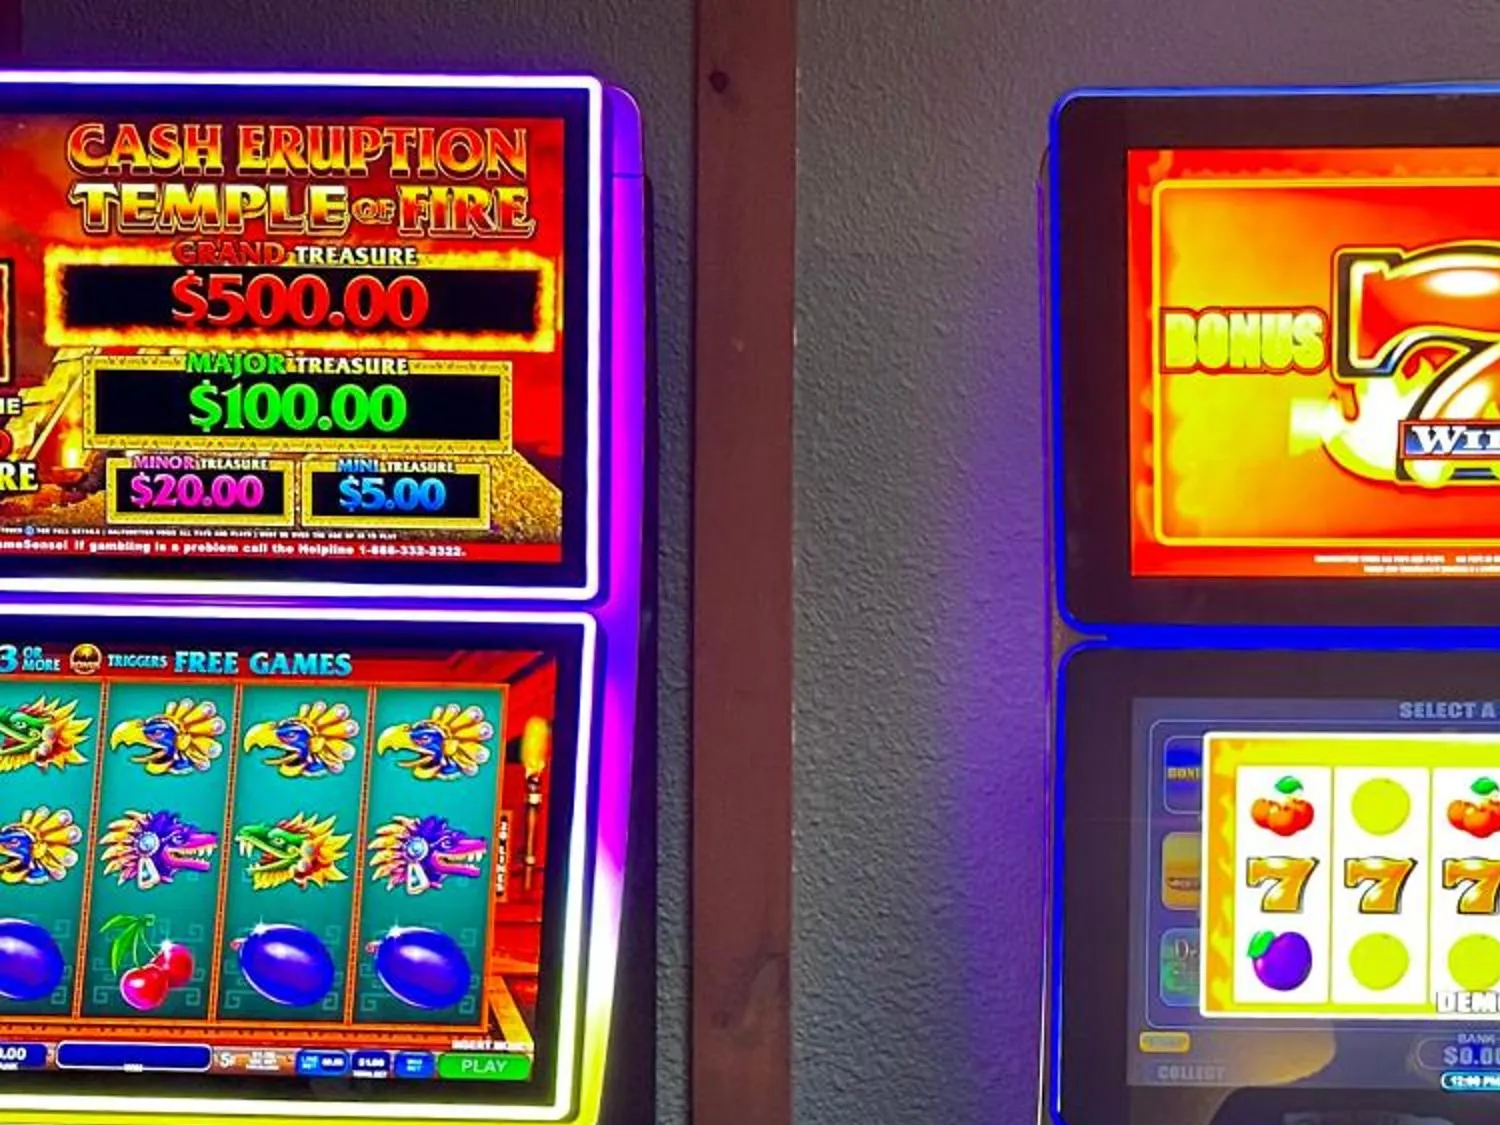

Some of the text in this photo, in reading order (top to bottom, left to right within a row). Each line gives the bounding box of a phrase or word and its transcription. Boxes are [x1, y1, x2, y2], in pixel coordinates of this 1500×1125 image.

[67, 123, 528, 180] CASH ERUPTION
[69, 182, 536, 239] TEMPLE OF FIRE
[174, 241, 417, 266] GRAND TREASURE
[171, 270, 429, 330] $500.00
[1162, 310, 1328, 371] BONUS
[186, 353, 410, 379] MAJOR TREASURE
[189, 380, 408, 433] $100.00
[133, 455, 268, 471] MINOR TREASURE
[338, 459, 456, 473] MINI TREASURE
[131, 472, 265, 508] $20.00
[339, 474, 447, 512] $5.00
[90, 540, 151, 554] gambling
[155, 541, 167, 551] is
[171, 543, 180, 552] a
[183, 541, 239, 555] problem
[243, 543, 268, 553] call
[272, 543, 295, 554] the
[298, 543, 355, 557] Helpline
[0, 644, 43, 673] 3 OR
[22, 659, 61, 671] MORE
[107, 653, 168, 669] TRIGGERS
[174, 651, 239, 674] FREE
[249, 652, 353, 676] GAMES
[1400, 701, 1477, 719] SELECT
[1481, 701, 1496, 719] A
[1246, 856, 1320, 915] 7
[1343, 857, 1418, 915] 7
[1457, 1034, 1495, 1044] BANK
[461, 1058, 508, 1073] PLAY
[1157, 1065, 1226, 1080] COLLECT
